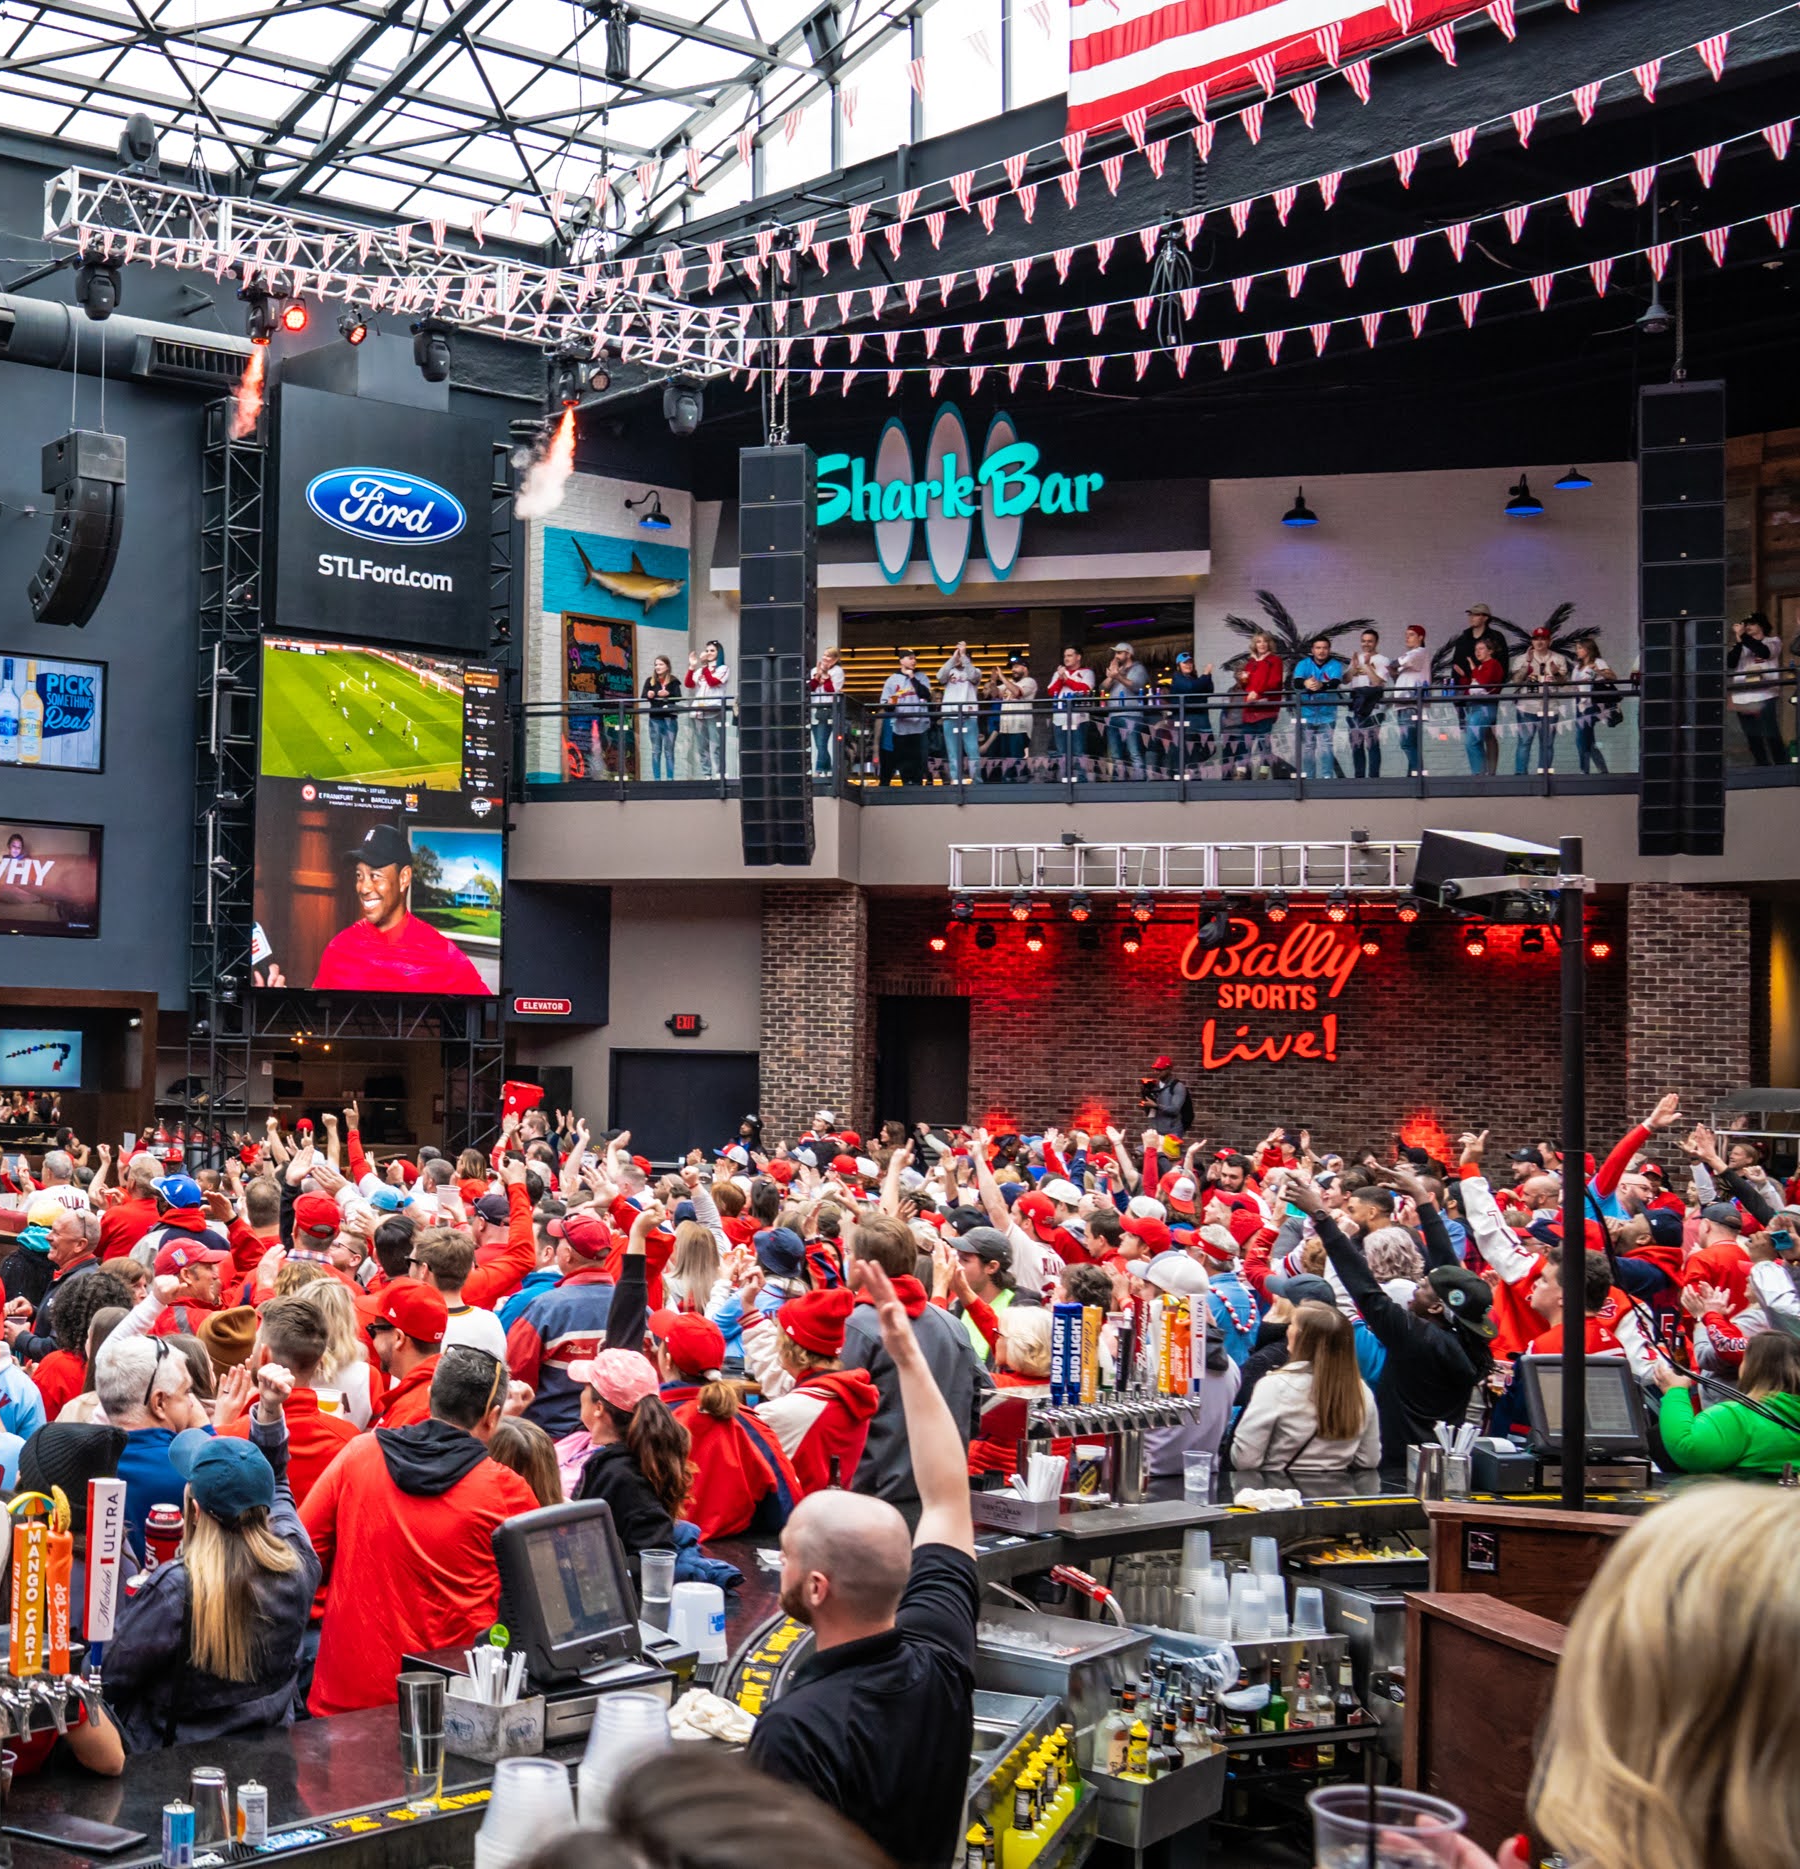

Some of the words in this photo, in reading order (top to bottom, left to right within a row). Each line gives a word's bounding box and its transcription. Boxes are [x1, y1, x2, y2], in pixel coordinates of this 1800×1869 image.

[816, 452, 977, 526] Shark
[978, 441, 1103, 518] Bar
[338, 477, 435, 534] Ford
[317, 553, 453, 592] STLFord.com
[46, 673, 94, 696] PICK
[46, 692, 95, 710] SOMETHING
[44, 707, 93, 732] Real
[323, 793, 354, 801] FRANKFURT
[370, 796, 402, 806] BARCELONA
[1180, 917, 1363, 997] Bally
[522, 1000, 564, 1013] ELEVATOR
[1217, 983, 1317, 1012] SPORTS
[676, 1015, 696, 1030] EXIT
[1202, 1014, 1337, 1070] Live!
[1053, 1316, 1066, 1355] LIGHT
[1070, 1316, 1082, 1355] LIGHT
[1052, 1355, 1063, 1384] BUD
[1069, 1355, 1081, 1383] BUD
[103, 1492, 119, 1554] ULTRA
[25, 1529, 41, 1603] MANGO
[55, 1582, 68, 1609] TOP
[98, 1568, 114, 1628] Michelob
[23, 1607, 38, 1666] CART
[55, 1610, 68, 1651] SHOCK
